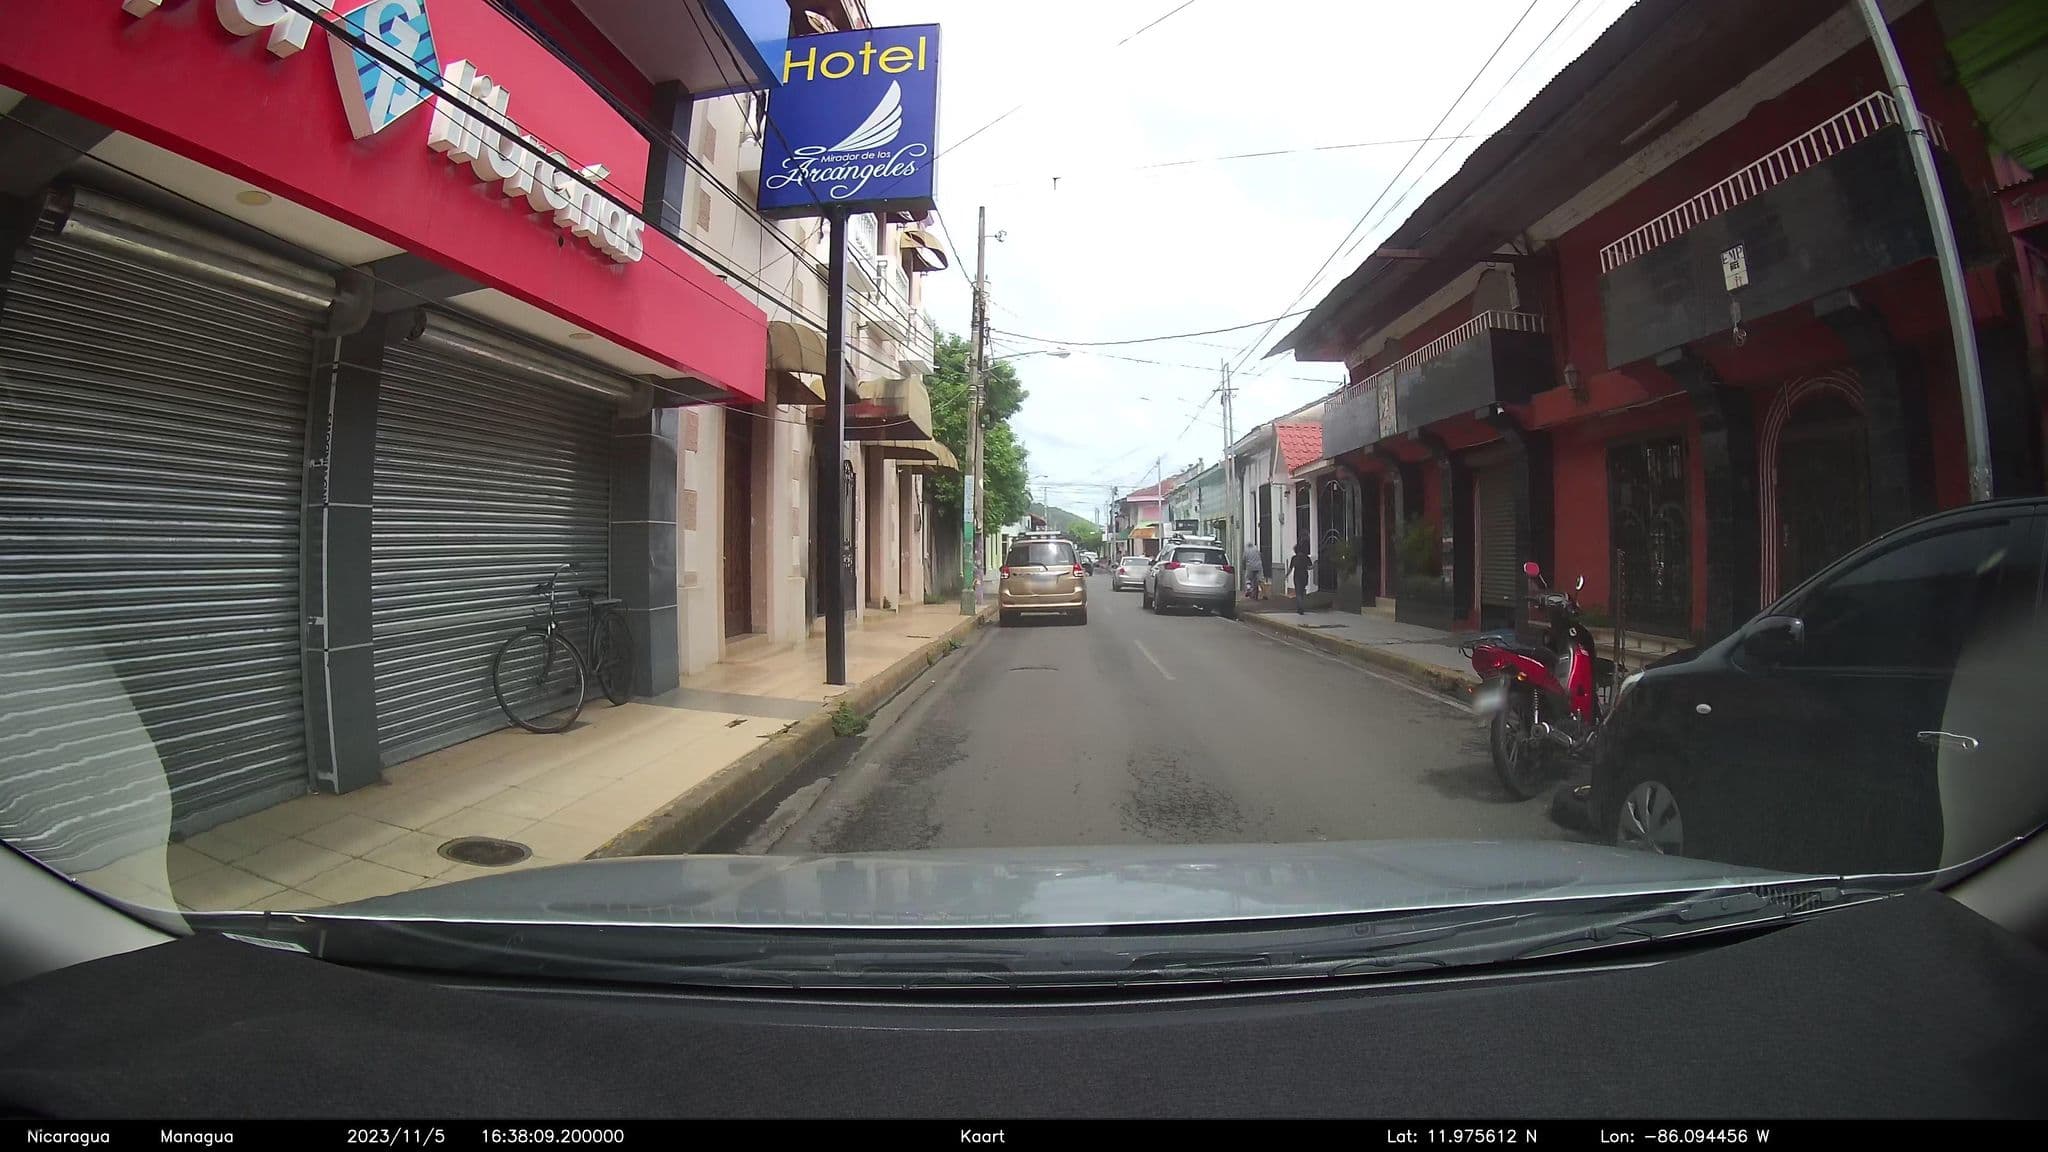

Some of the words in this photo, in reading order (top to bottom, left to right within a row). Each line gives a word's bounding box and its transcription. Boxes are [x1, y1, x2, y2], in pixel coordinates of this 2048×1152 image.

[782, 36, 927, 84] Hotel
[766, 143, 928, 199] Arcángeles
[820, 153, 860, 163] Mirador
[861, 151, 875, 160] de
[877, 150, 892, 159] los
